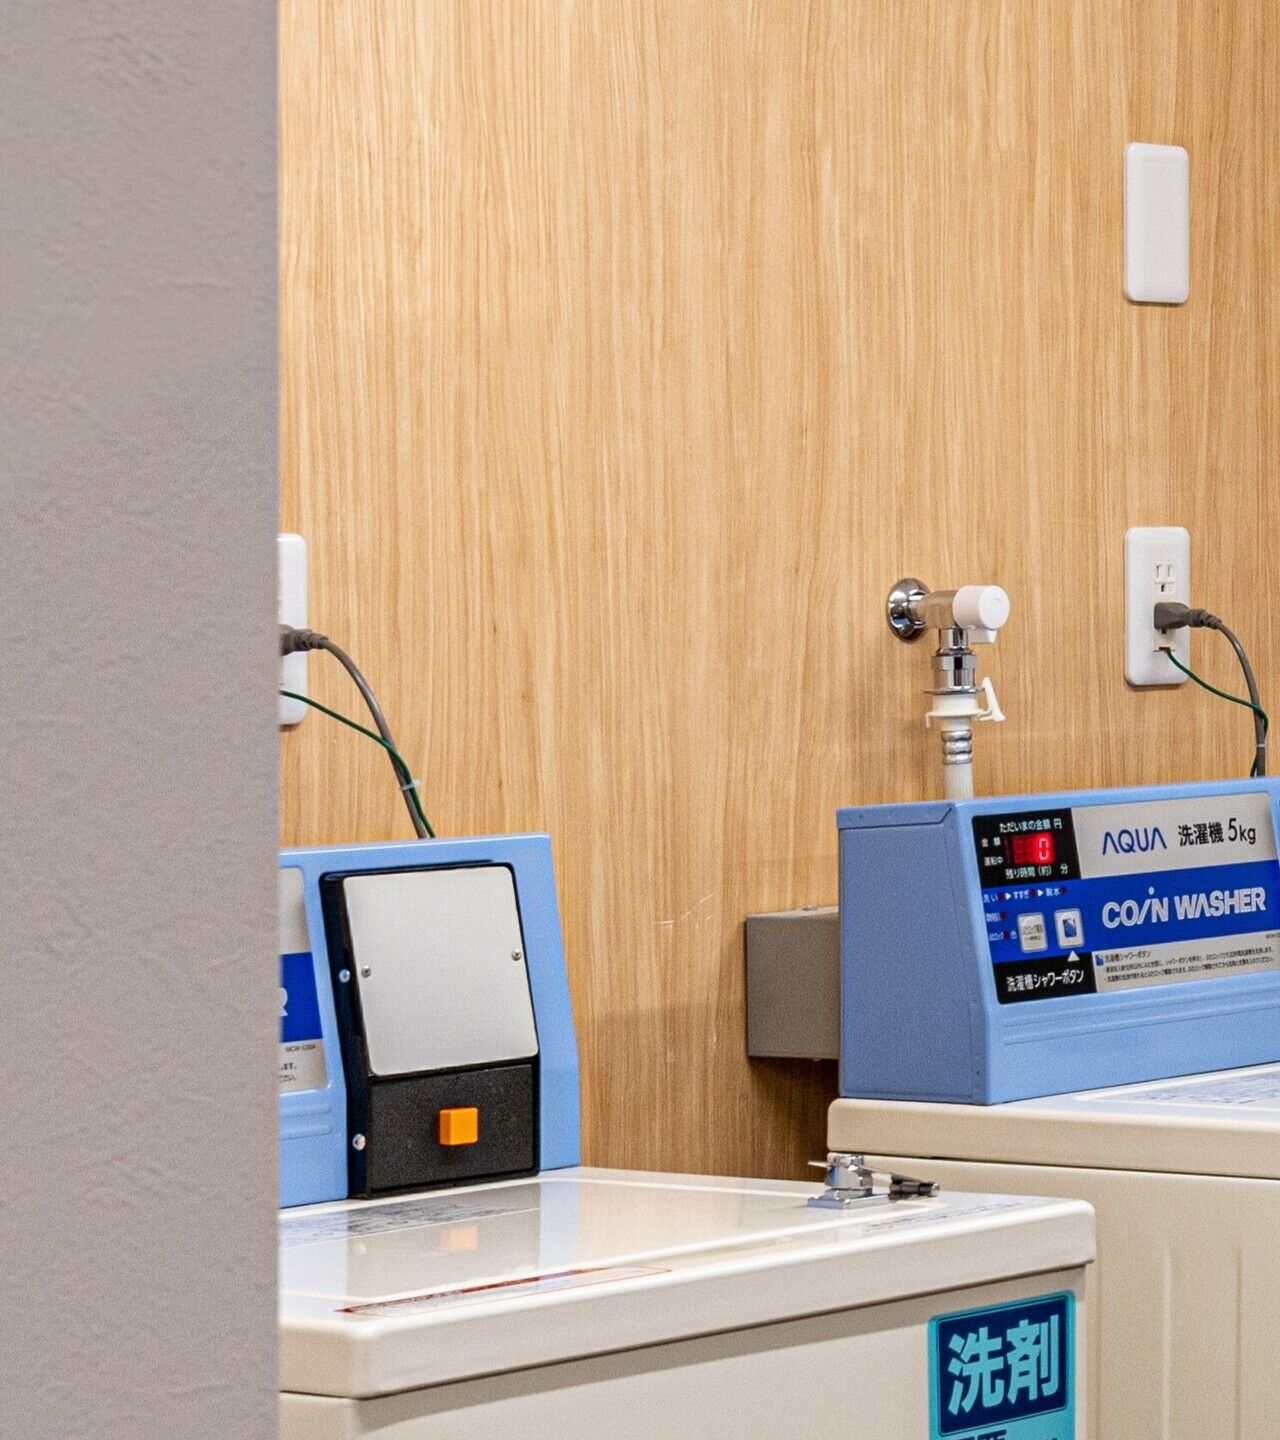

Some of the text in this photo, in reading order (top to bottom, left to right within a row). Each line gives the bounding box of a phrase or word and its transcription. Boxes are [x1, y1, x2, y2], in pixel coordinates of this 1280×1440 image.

[999, 818, 1063, 833] ただいまの金額 円
[1102, 818, 1256, 855] AQUA 洗濯機 5kg
[1038, 837, 1049, 860] 0
[1102, 886, 1267, 929] COIN WASHER
[1006, 968, 1084, 992] 洗濯槽シャワーボタン
[947, 1314, 1060, 1416] 洗剤
